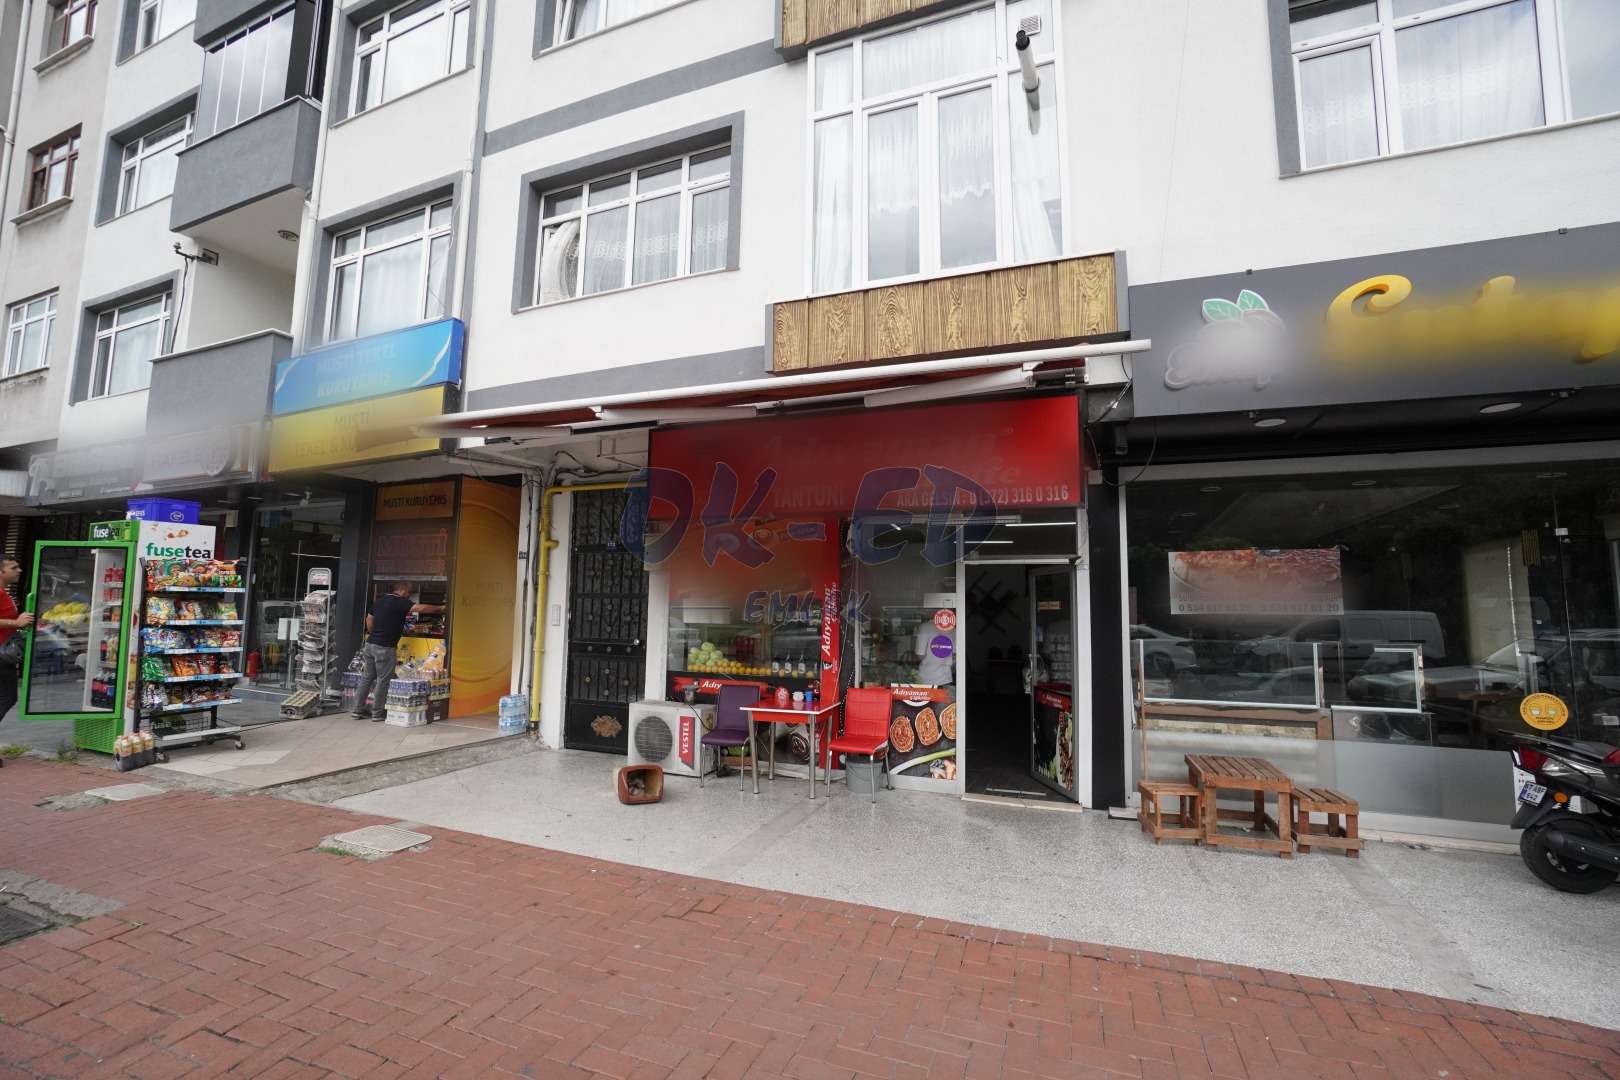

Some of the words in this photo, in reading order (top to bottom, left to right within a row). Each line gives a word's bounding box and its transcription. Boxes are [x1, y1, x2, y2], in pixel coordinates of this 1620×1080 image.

[1011, 487, 1033, 504] 316
[1036, 486, 1044, 503] 0
[1046, 485, 1068, 502] 316
[146, 542, 212, 559] fusetea
[682, 720, 690, 754] VESTEL
